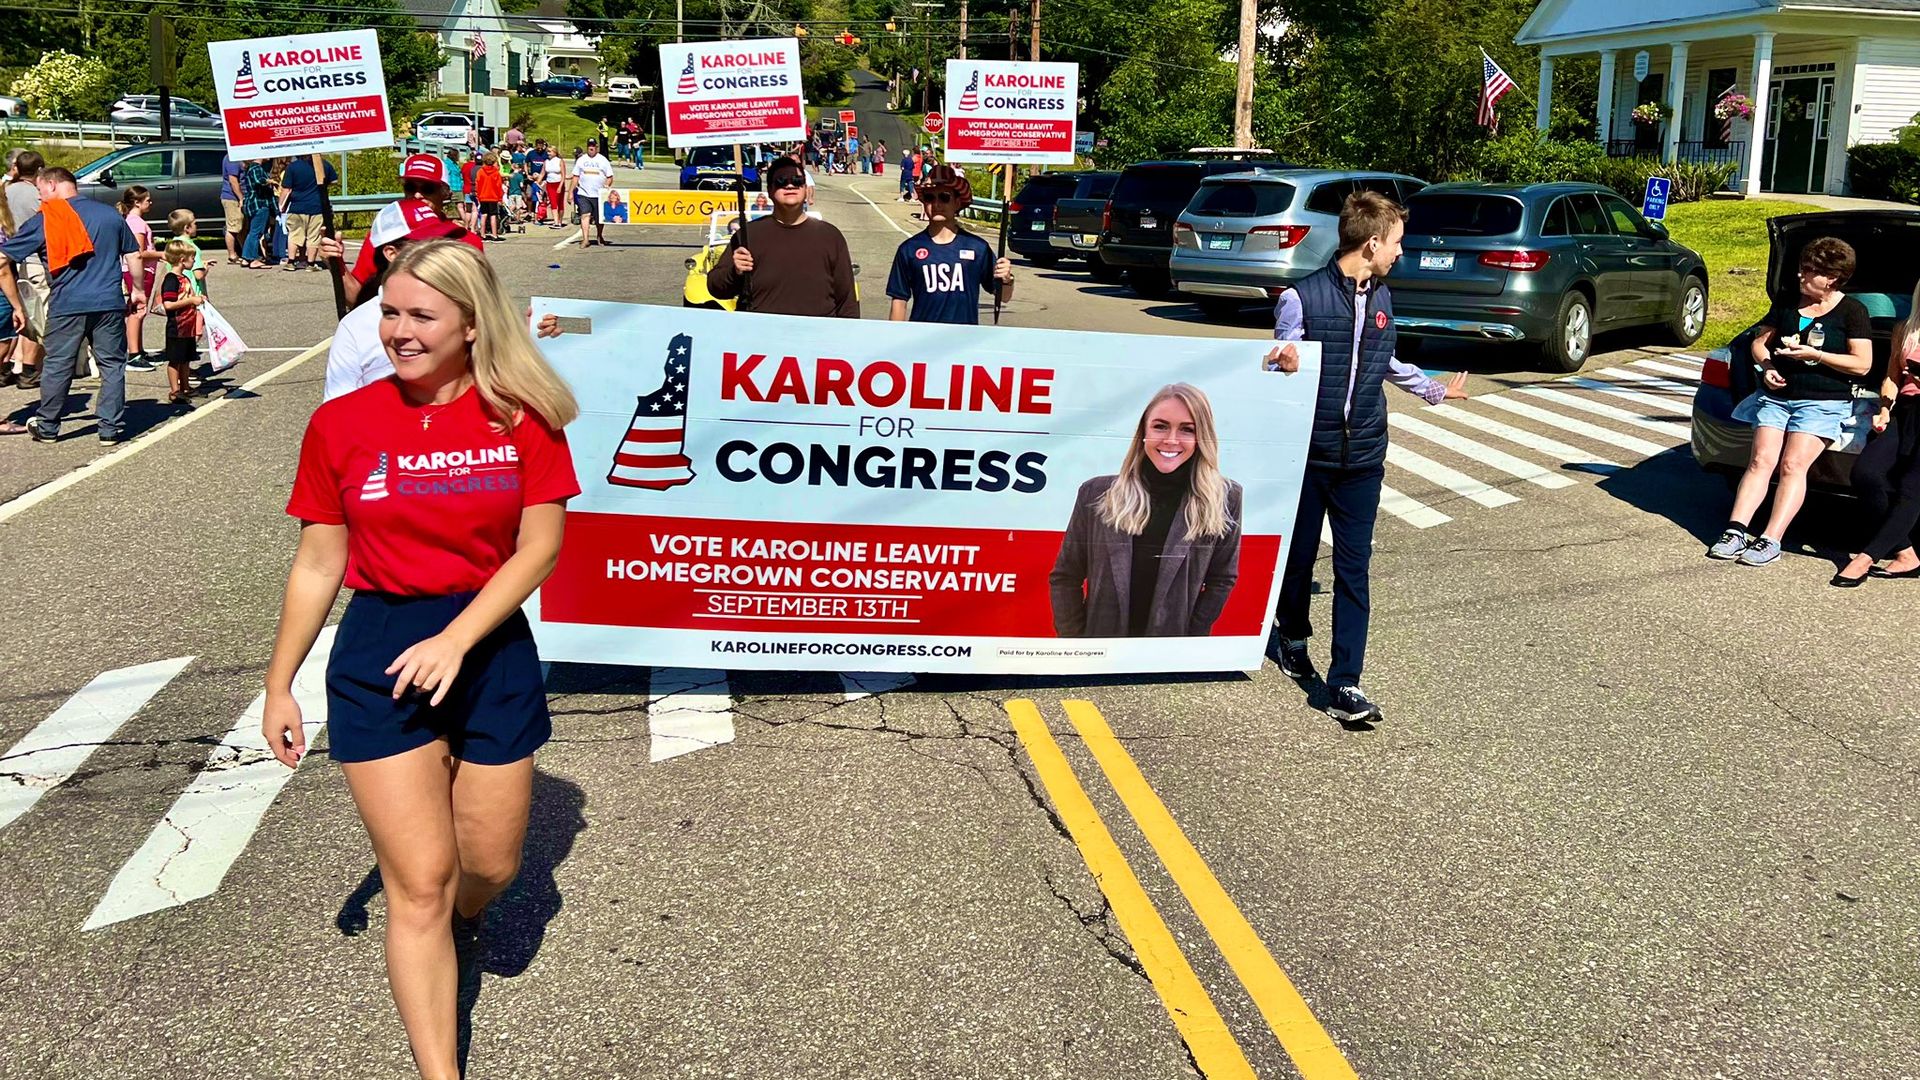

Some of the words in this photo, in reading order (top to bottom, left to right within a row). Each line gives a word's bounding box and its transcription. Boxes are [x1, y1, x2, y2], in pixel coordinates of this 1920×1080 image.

[258, 45, 362, 68] KAROLINE
[701, 51, 786, 68] KAROLINE
[303, 65, 322, 74] FOR
[263, 72, 367, 93] CONGRESS
[703, 74, 788, 90] CONGRESS
[984, 74, 1065, 89] KAROLINE
[249, 110, 274, 119] VOTE
[275, 105, 320, 116] KAROLINE
[322, 102, 357, 111] LEAVITT
[689, 104, 710, 112] VOTE
[711, 102, 748, 110] KAROLINE
[750, 100, 779, 108] LEAVITT
[984, 97, 1065, 110] CONGRESS
[239, 116, 304, 129] HOMEGROWN
[305, 109, 377, 123] CONSERVATIVE
[680, 111, 734, 120] HOMEGROWN
[735, 107, 794, 117] CONSERVATIVE
[273, 125, 320, 137] SEPTEMBER
[321, 123, 341, 131] 13TH
[925, 118, 943, 127] STOP
[968, 121, 987, 129] VOTE
[988, 122, 1025, 130] KAROLINE
[958, 129, 1010, 138] HOMEGROWN
[1011, 131, 1067, 139] CONSERVATIVE
[633, 200, 665, 216] You
[672, 201, 695, 216] Go
[922, 263, 964, 293] USA
[720, 352, 1055, 414] KAROLINE
[859, 416, 915, 439] FOR
[397, 445, 519, 471] KAROLINE
[715, 440, 1048, 493] CONGRESS
[448, 467, 471, 477] FOR
[397, 475, 519, 496] CONGRESS
[649, 534, 723, 557] VOTE
[730, 538, 867, 562] KAROLINE
[875, 542, 980, 565] LEAVITT
[606, 559, 803, 586] HOMEGROWN
[810, 567, 1017, 592] CONSERVATIVE
[707, 594, 847, 617] SEPTEMBER
[854, 599, 909, 618] 13TH
[711, 640, 972, 658] KAROLINEFORCONGRESS.COM
